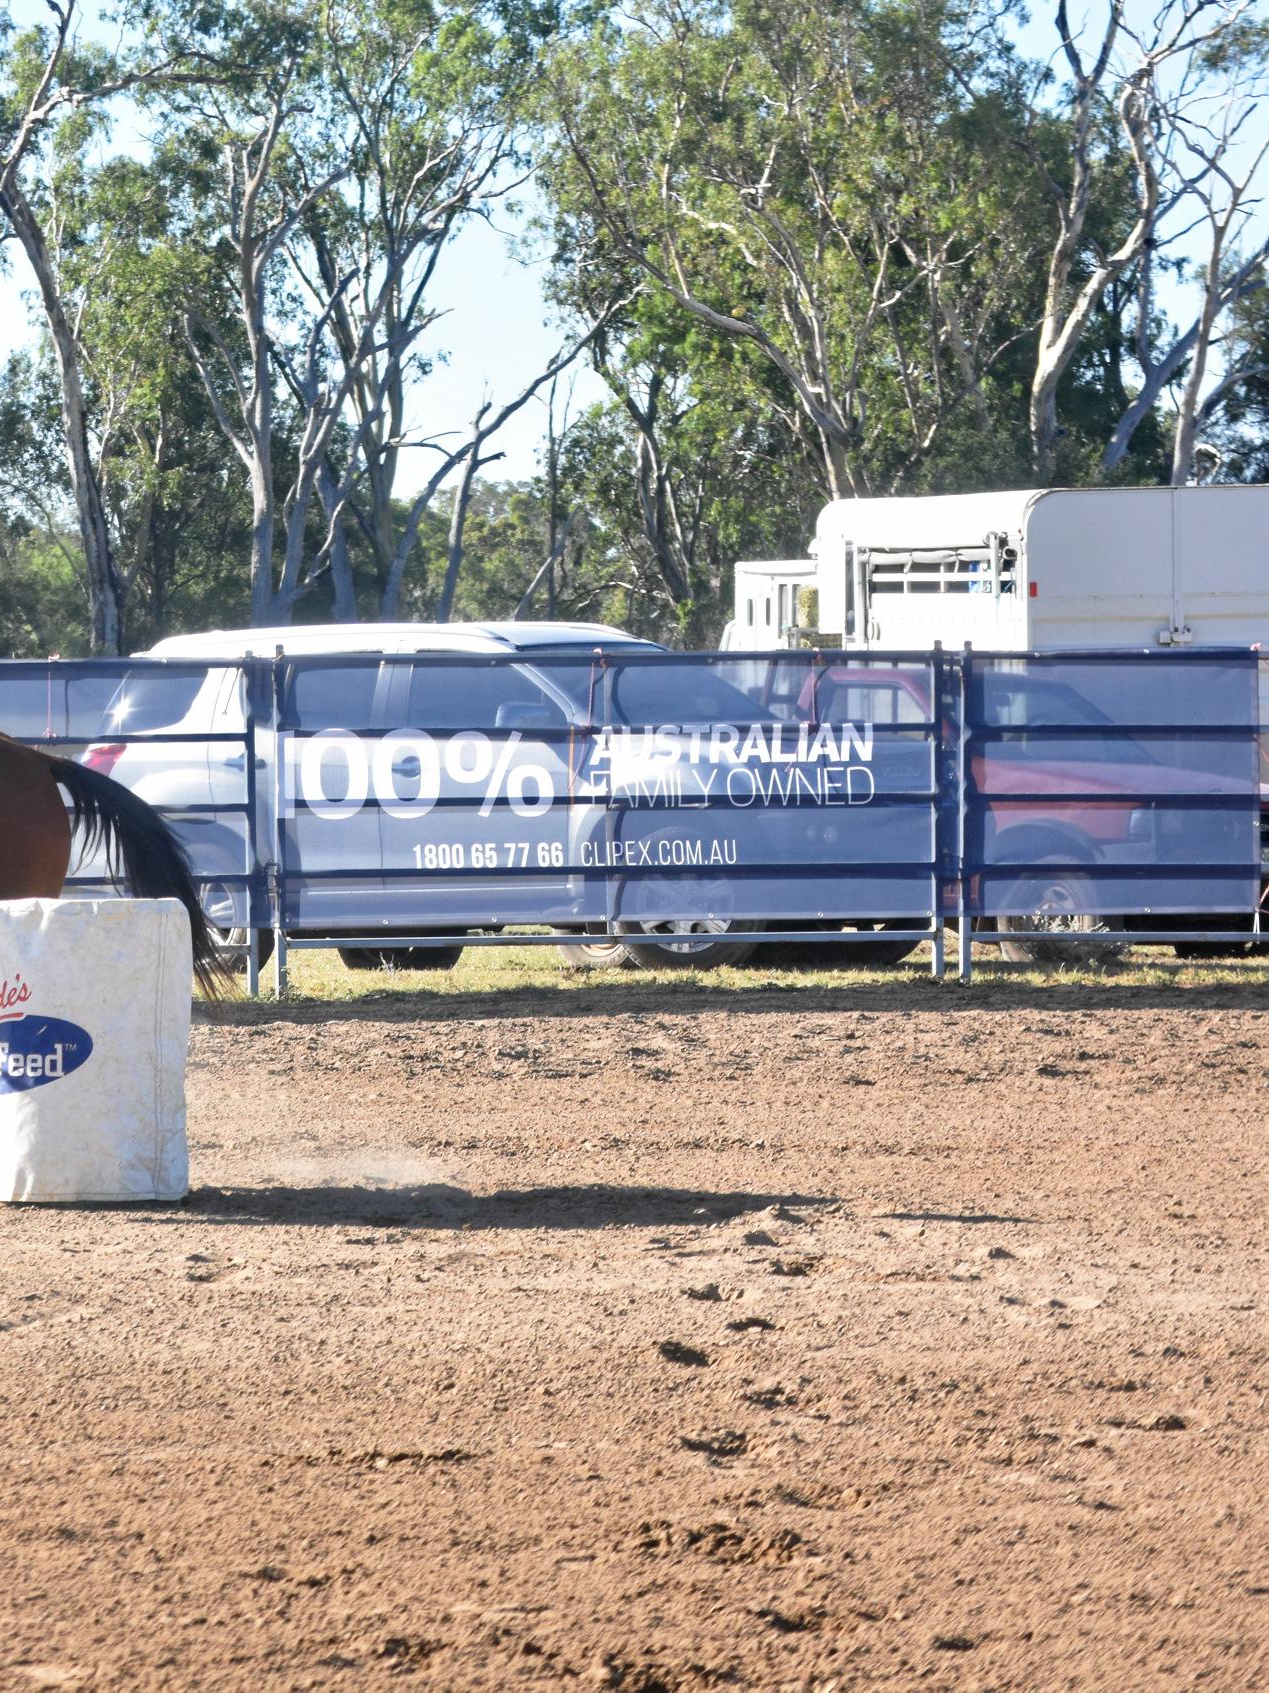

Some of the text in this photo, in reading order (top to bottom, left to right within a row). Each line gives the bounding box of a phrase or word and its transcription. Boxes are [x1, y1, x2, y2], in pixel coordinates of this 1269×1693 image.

[589, 722, 874, 765] AUSTRALIAN
[277, 728, 555, 820] 100%
[590, 766, 875, 808] FAMILY OWNED
[413, 839, 738, 869] 1800 65 77 66 CLIPEX.COM.AU
